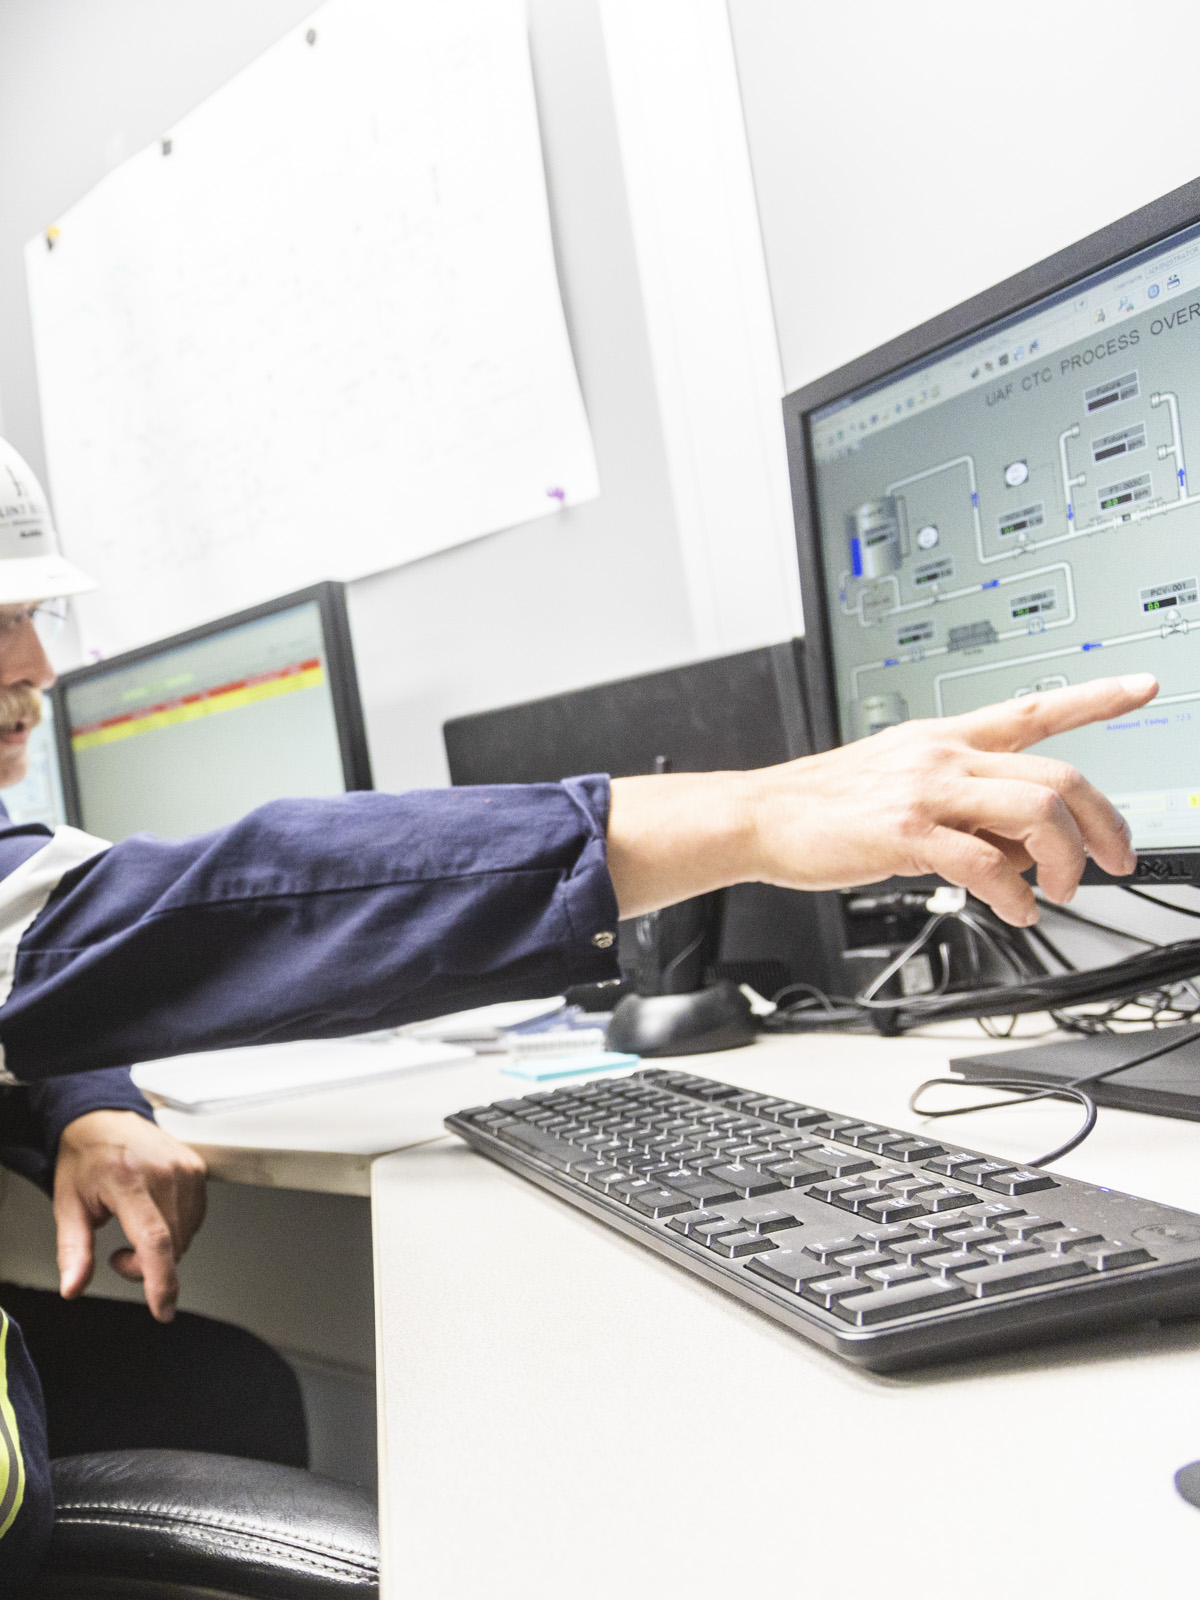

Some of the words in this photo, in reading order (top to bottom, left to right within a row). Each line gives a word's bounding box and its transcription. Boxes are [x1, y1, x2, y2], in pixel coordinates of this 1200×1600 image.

[985, 383, 1014, 407] UAF
[1021, 367, 1053, 392] CTC
[1059, 329, 1141, 375] PROCESS
[1150, 302, 1200, 336] OVER
[1137, 859, 1192, 880] DELL
